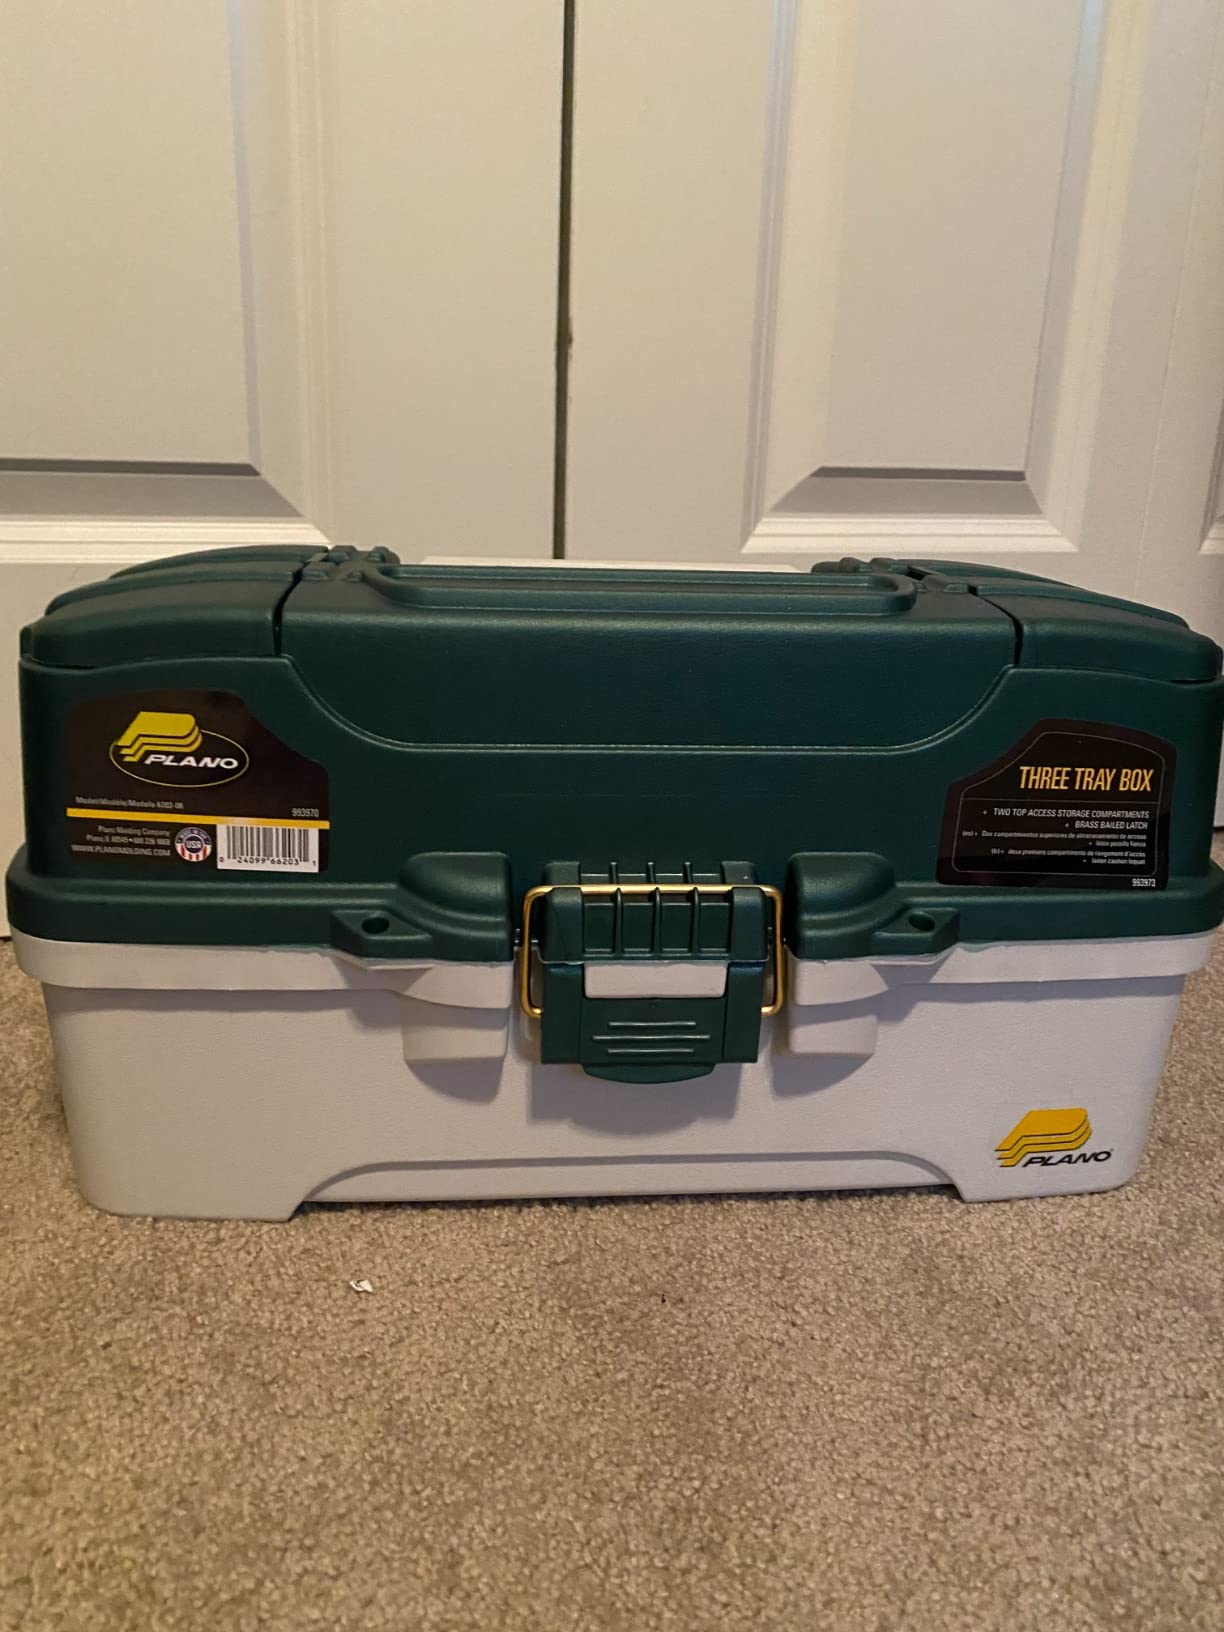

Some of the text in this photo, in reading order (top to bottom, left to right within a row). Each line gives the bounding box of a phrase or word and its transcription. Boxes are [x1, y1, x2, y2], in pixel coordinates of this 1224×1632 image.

[144, 754, 239, 769] PLANO
[1019, 766, 1154, 792] THREE TRAY BOX
[291, 808, 319, 818] 993970
[993, 807, 1150, 819] TWO TOP ACCESS STORAGE COMPARTMENTS
[1074, 820, 1148, 830] BRASS BAILED LATCH
[185, 840, 202, 848] USA
[237, 856, 266, 864] 24099
[270, 857, 300, 866] 66203
[1022, 1150, 1111, 1168] PLANO
